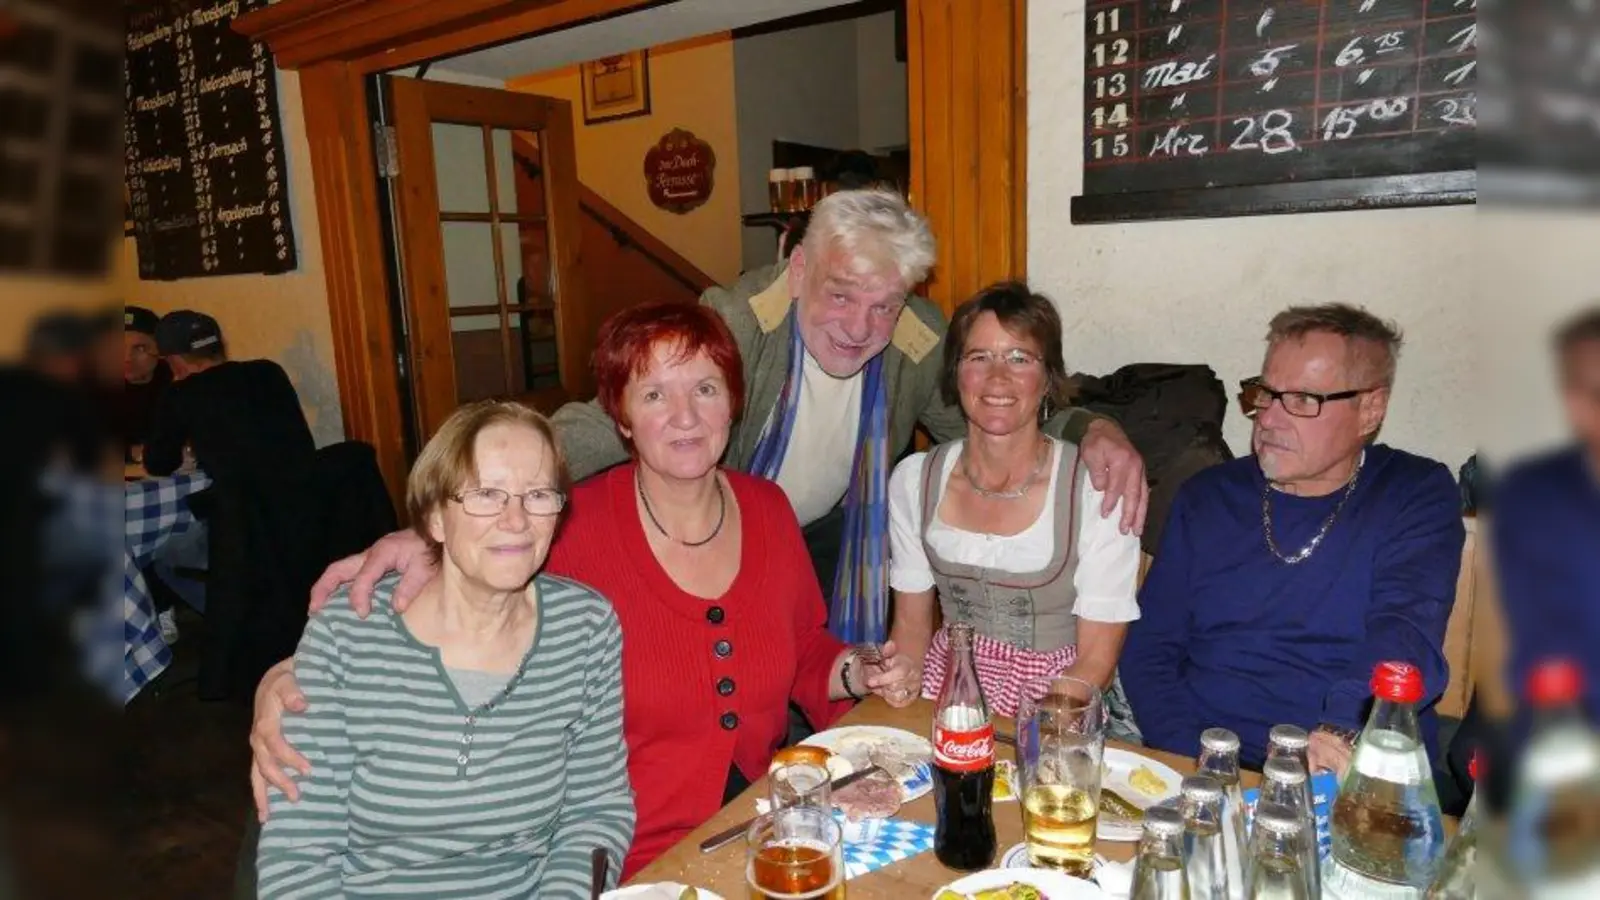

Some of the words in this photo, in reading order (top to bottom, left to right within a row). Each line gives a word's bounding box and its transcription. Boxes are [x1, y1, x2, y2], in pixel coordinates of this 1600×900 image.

[1093, 8, 1120, 35] 11
[1092, 38, 1130, 68] 12
[1092, 73, 1127, 99] 13
[1091, 102, 1128, 130] 14
[1230, 109, 1297, 155] 28
[1091, 133, 1129, 160] 15
[943, 737, 990, 758] Coca-Cola
